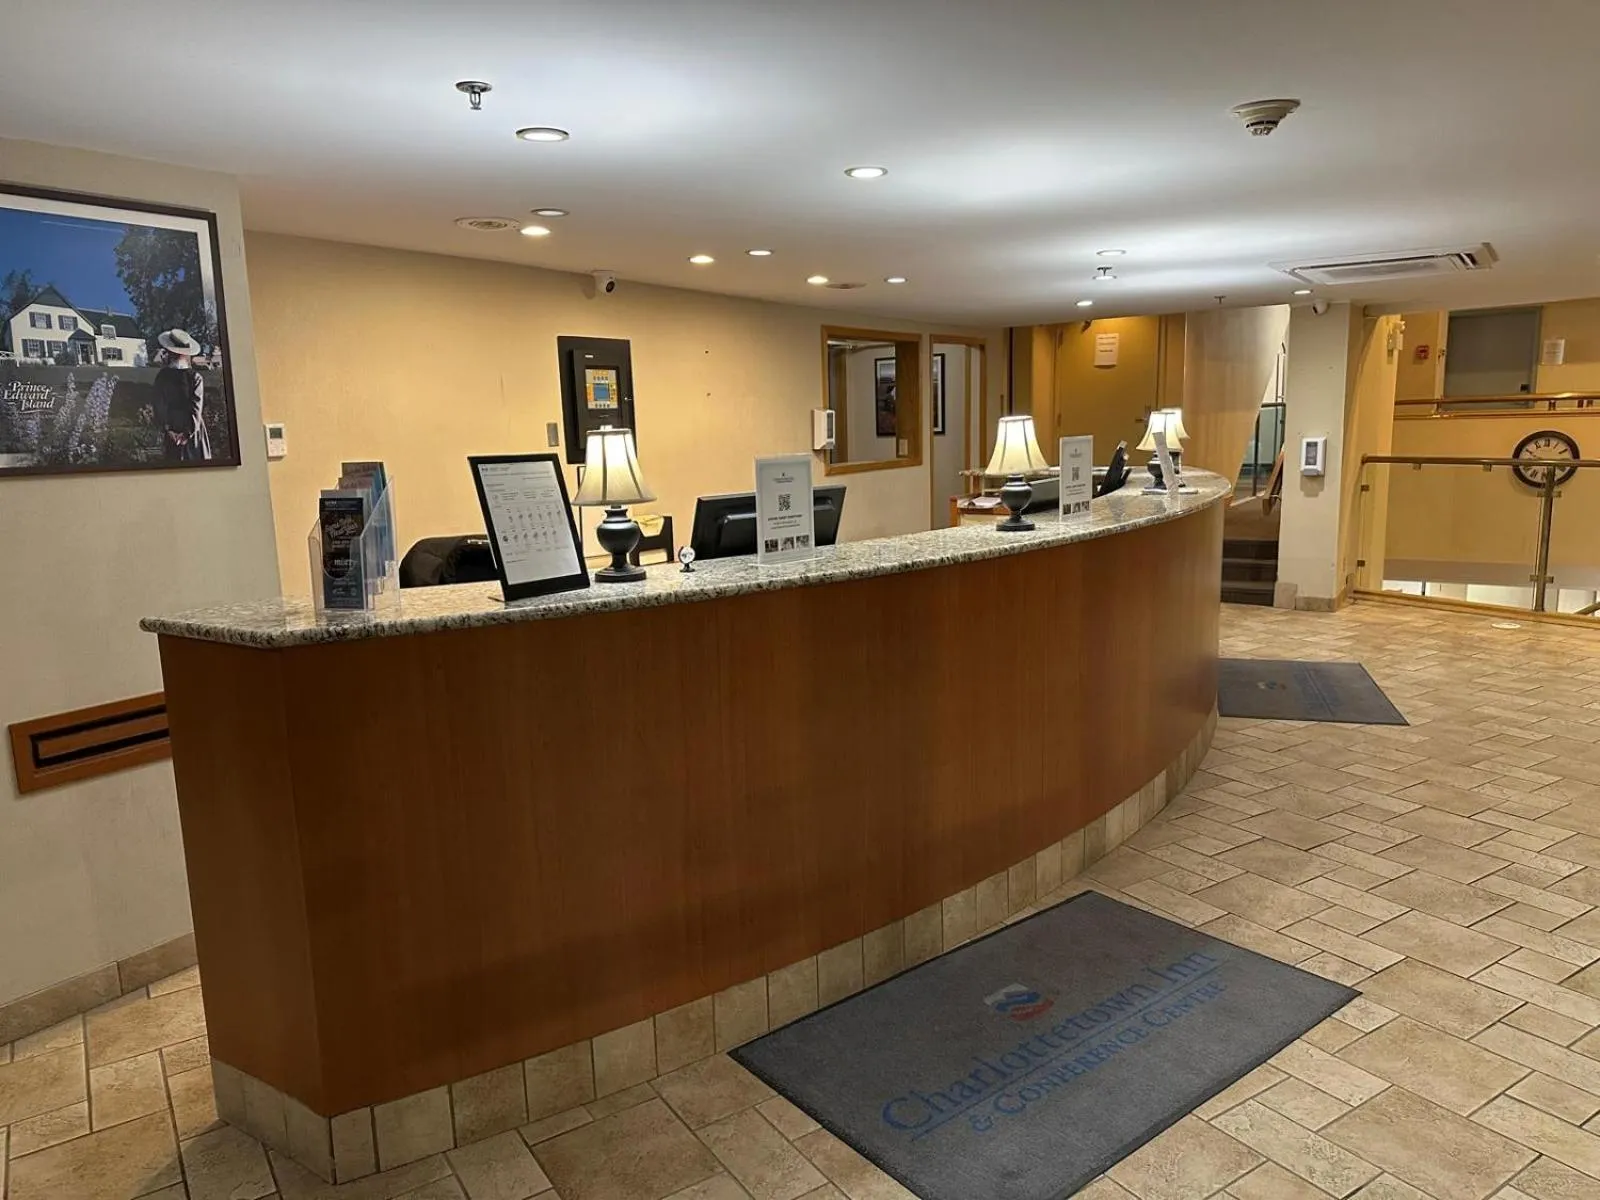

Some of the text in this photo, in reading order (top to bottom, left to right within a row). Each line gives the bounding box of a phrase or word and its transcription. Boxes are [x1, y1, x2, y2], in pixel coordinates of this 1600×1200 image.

[8, 381, 52, 392] Prince
[3, 388, 51, 400] Edward
[20, 397, 55, 411] Island
[881, 950, 1217, 1132] Charlottetown Inn
[969, 1112, 994, 1133] &
